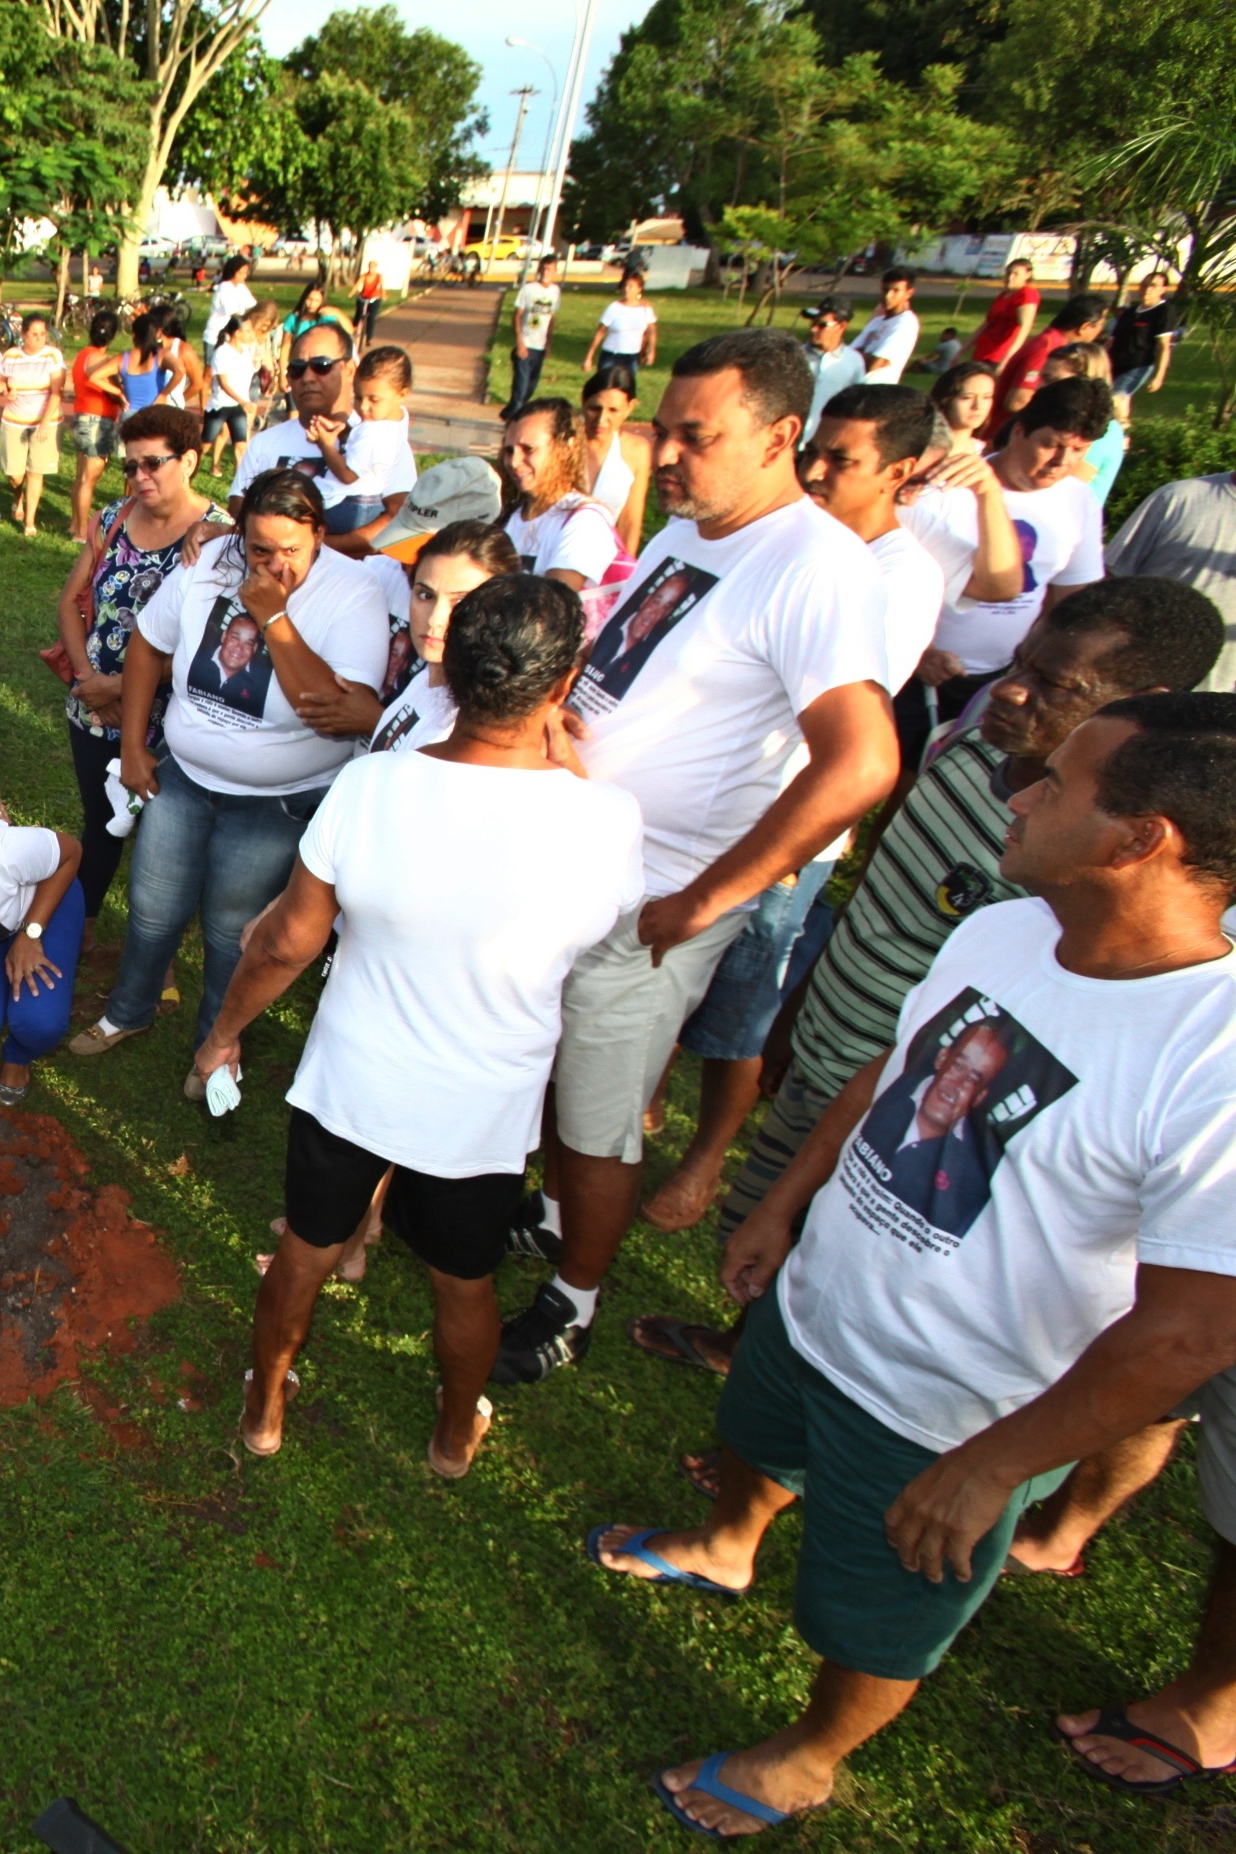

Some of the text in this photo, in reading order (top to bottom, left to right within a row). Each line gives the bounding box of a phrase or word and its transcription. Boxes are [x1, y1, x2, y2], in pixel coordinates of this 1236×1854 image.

[188, 685, 225, 703] FABIANO
[853, 1136, 893, 1181] ABIANO
[875, 1203, 900, 1224] gente
[901, 1221, 941, 1253] descobre
[943, 1249, 951, 1257] o
[890, 1227, 907, 1243] que
[908, 1240, 923, 1254] ele
[894, 1201, 925, 1228] Quando
[933, 1232, 960, 1248] outro
